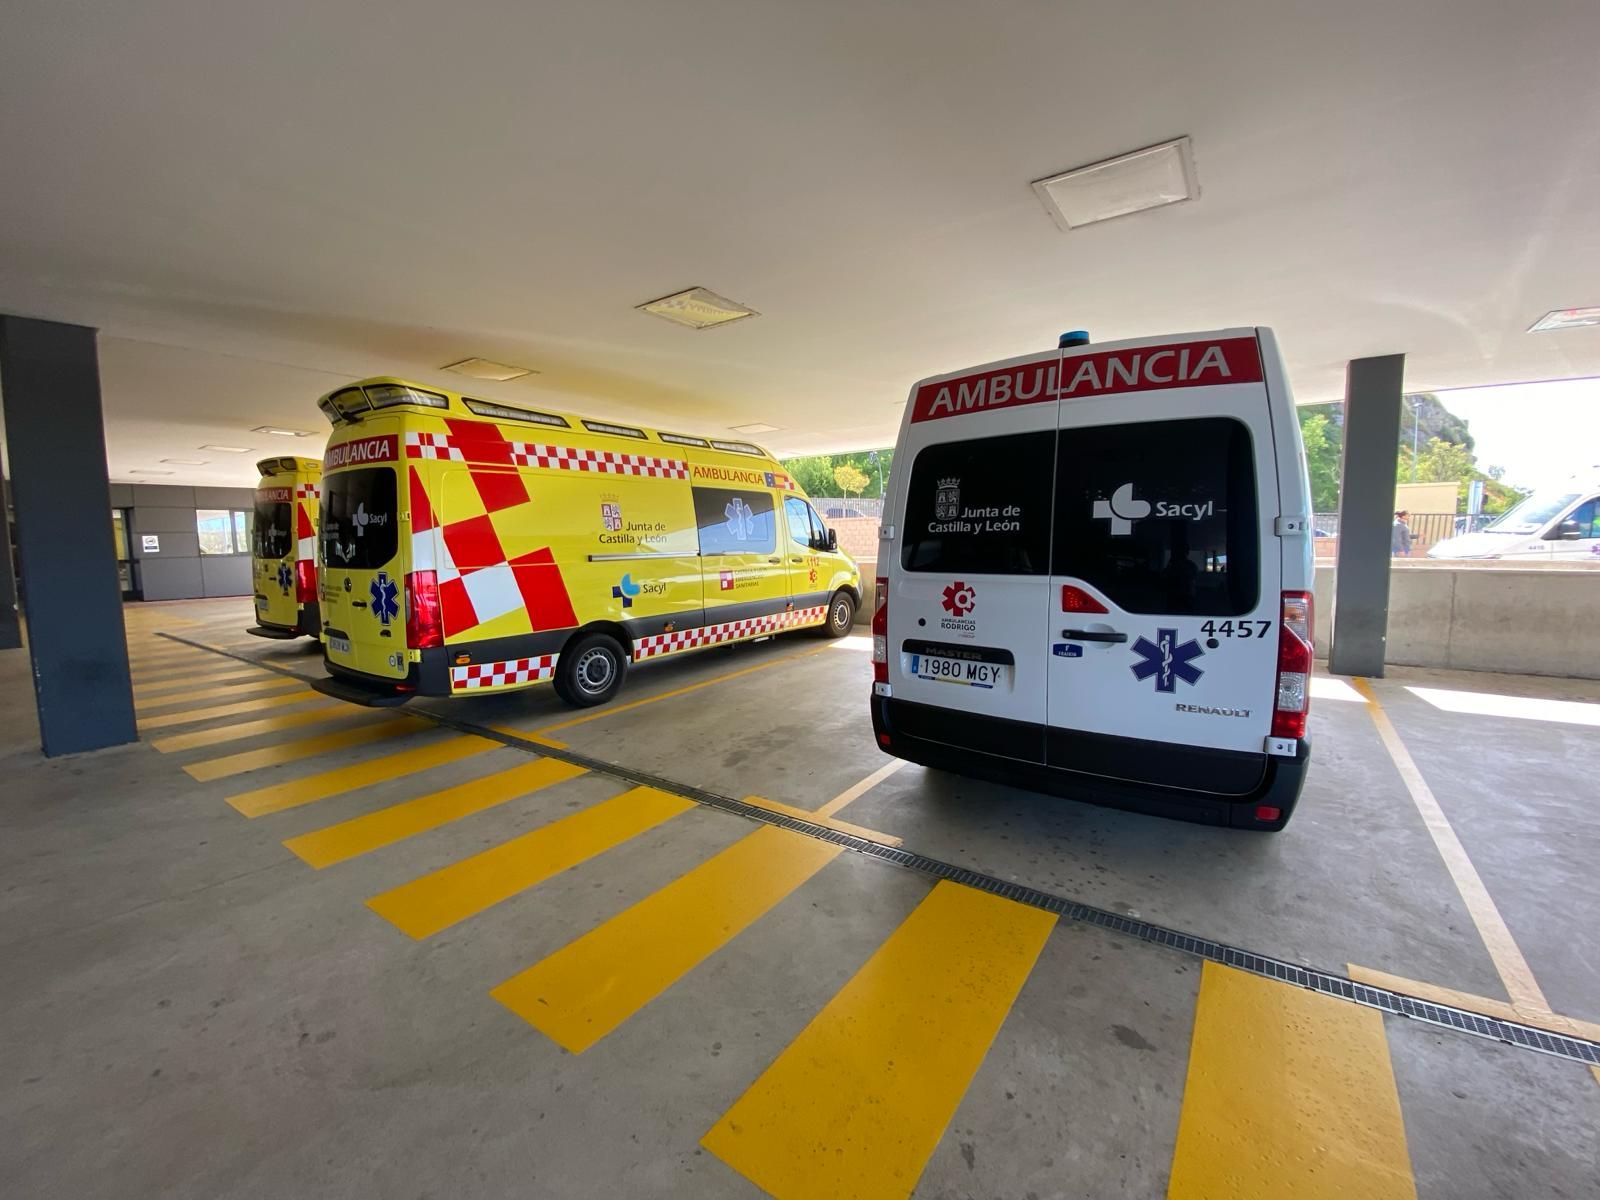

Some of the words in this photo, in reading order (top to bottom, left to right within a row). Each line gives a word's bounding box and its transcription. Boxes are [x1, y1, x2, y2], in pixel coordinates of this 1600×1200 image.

[928, 346, 1232, 416] AMBULANCIA
[693, 466, 765, 485] AMBULANCIA
[961, 507, 999, 518] Junta
[1002, 505, 1021, 517] de
[1155, 500, 1213, 521] Sacyl
[369, 512, 387, 526] Sacyl
[626, 521, 653, 531] Junta
[654, 522, 667, 532] de
[928, 521, 971, 533] Castilla
[973, 523, 983, 535] y
[985, 519, 1020, 532] León
[598, 533, 636, 544] Castilla
[636, 536, 644, 546] y
[645, 534, 668, 544] León
[643, 582, 666, 594] Sacyl
[941, 622, 976, 631] RODRIGO
[1200, 620, 1272, 639] 4457
[926, 647, 982, 660] MASTER
[924, 658, 961, 678] 1980
[966, 663, 1000, 683] MGY
[1175, 703, 1250, 718] RENAULT
